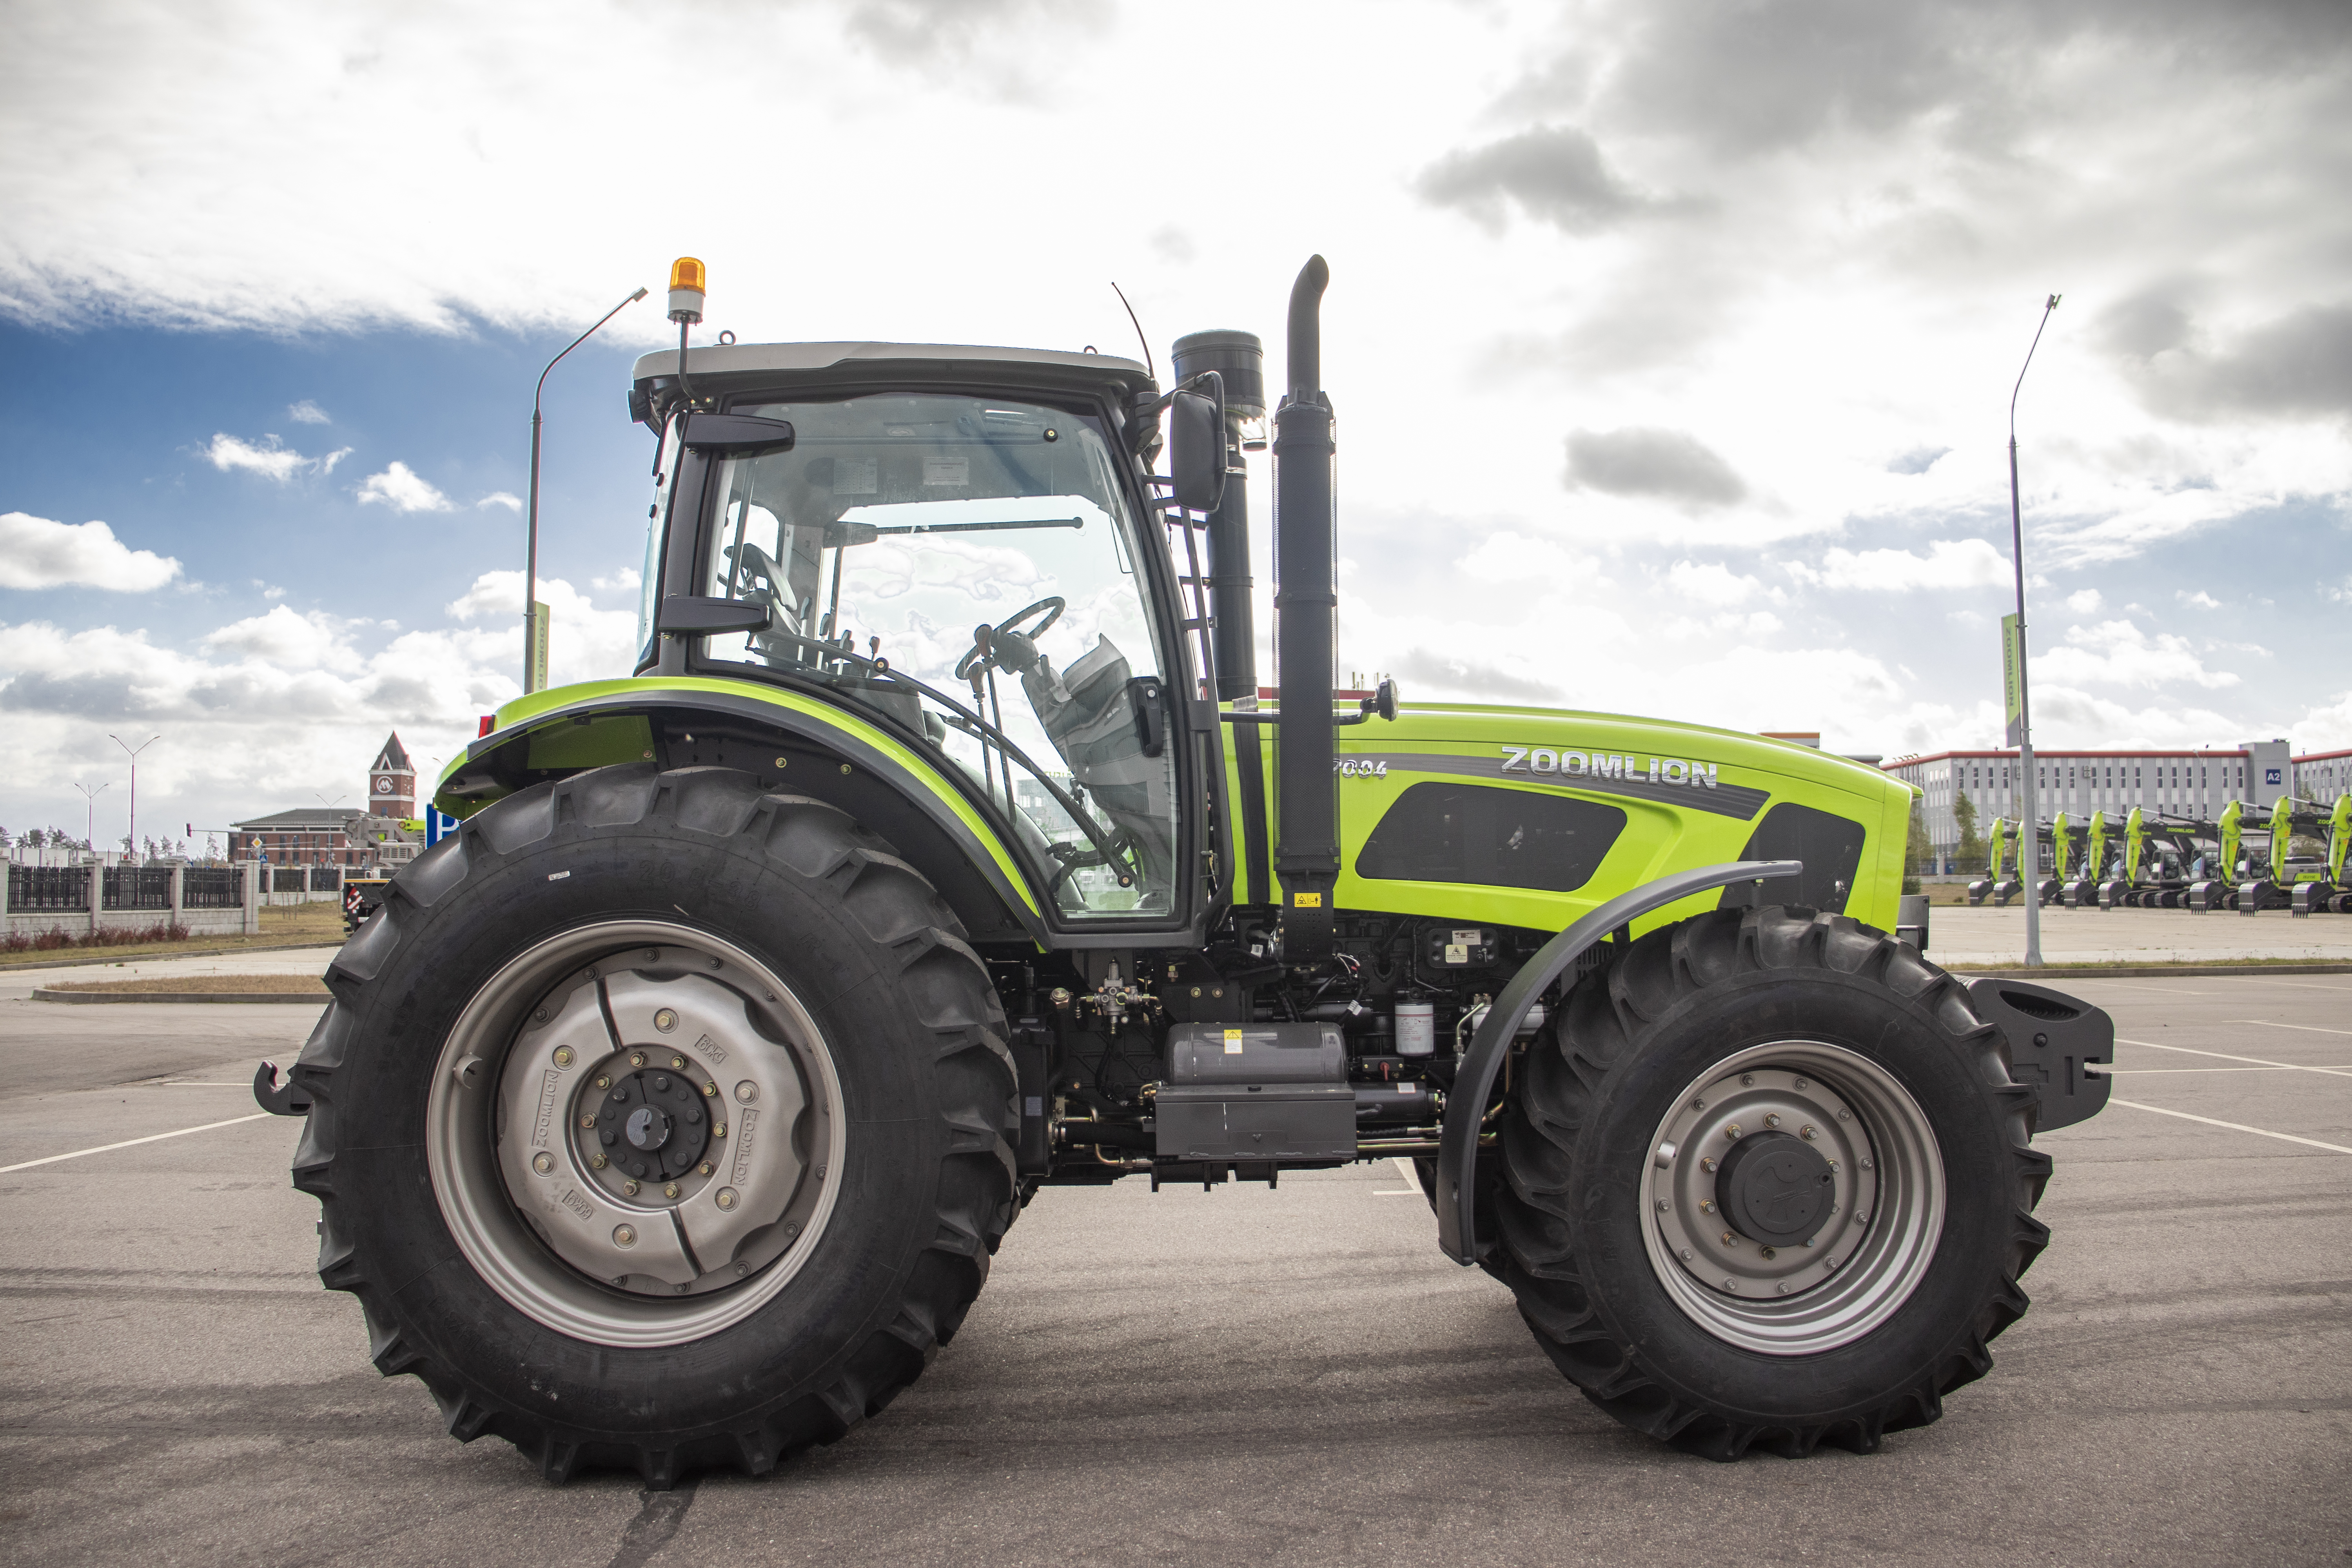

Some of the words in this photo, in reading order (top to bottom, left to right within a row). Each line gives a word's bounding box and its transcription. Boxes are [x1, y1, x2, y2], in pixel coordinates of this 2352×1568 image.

[1501, 746, 1717, 790] ZOOMLION
[2267, 773, 2280, 781] A2
[536, 1072, 558, 1147] ZOOMLION
[735, 1111, 757, 1186] ZOOMLION
